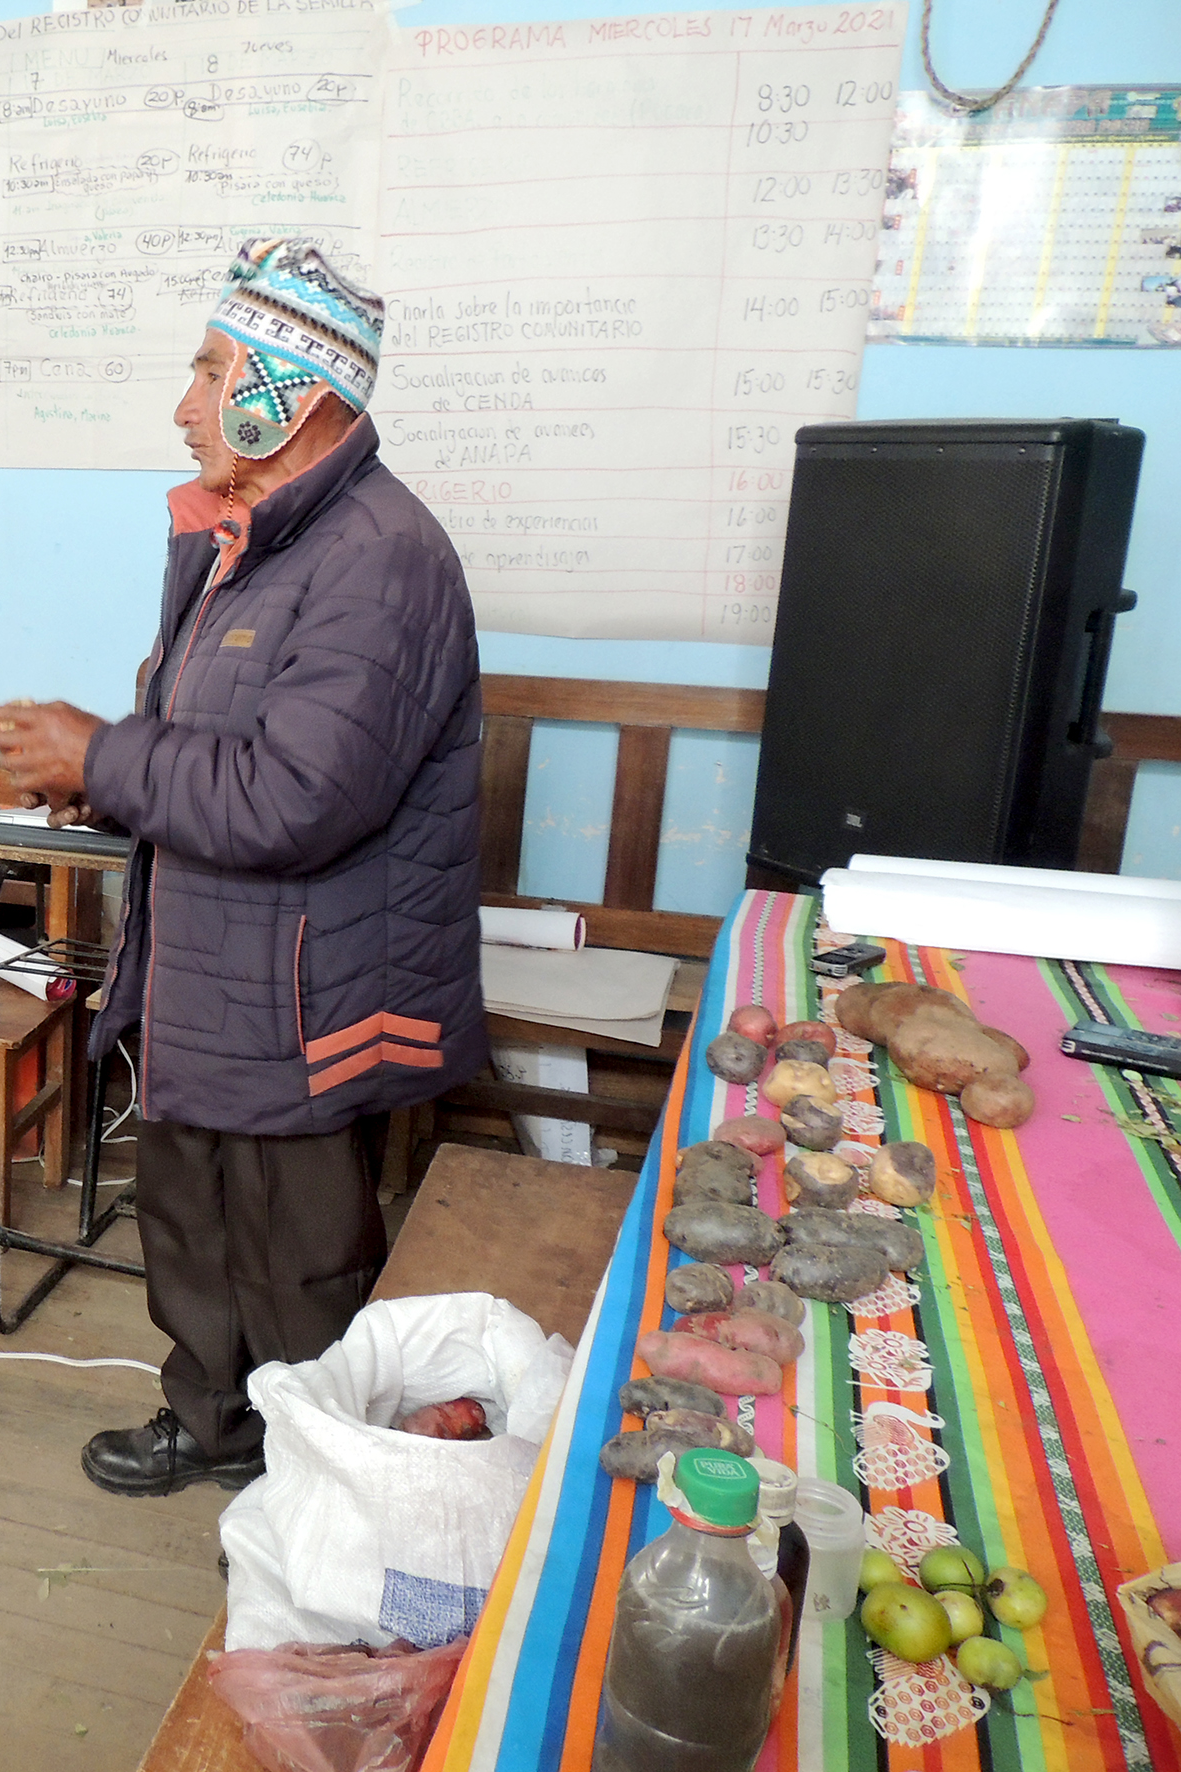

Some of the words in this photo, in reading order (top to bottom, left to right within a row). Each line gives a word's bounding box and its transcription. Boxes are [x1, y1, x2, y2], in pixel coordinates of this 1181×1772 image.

[237, 0, 260, 14] DE
[414, 25, 567, 57] PROGRAMA
[588, 15, 712, 45] MIERCOLES
[729, 15, 753, 38] 17
[832, 9, 896, 34] 2021
[757, 83, 811, 113] 8:30
[835, 81, 894, 107] 12:00
[745, 120, 810, 147] 10:30
[752, 176, 812, 204] 12:00
[831, 168, 884, 196] 13:30
[752, 224, 805, 253] 13:30
[823, 222, 877, 245] 14:00
[387, 296, 446, 322] Charla
[743, 295, 800, 322] 14:00
[819, 288, 870, 313] 15:00
[391, 323, 418, 348] del
[428, 320, 514, 347] REGISTRO
[520, 319, 644, 344] COMUNITARIO
[512, 361, 533, 384] de
[733, 368, 786, 397] 15:00
[806, 368, 858, 395] 15:30
[431, 394, 452, 413] de
[463, 391, 535, 412] CENDA
[505, 419, 522, 441] de
[727, 425, 781, 454] 15:30
[459, 443, 533, 468] ANAPA
[728, 470, 785, 492] 16:00
[483, 508, 500, 530] de
[727, 506, 777, 528] 16:00
[725, 544, 773, 564] 17:00
[724, 573, 776, 594] 18:00
[720, 602, 772, 625] 19:00
